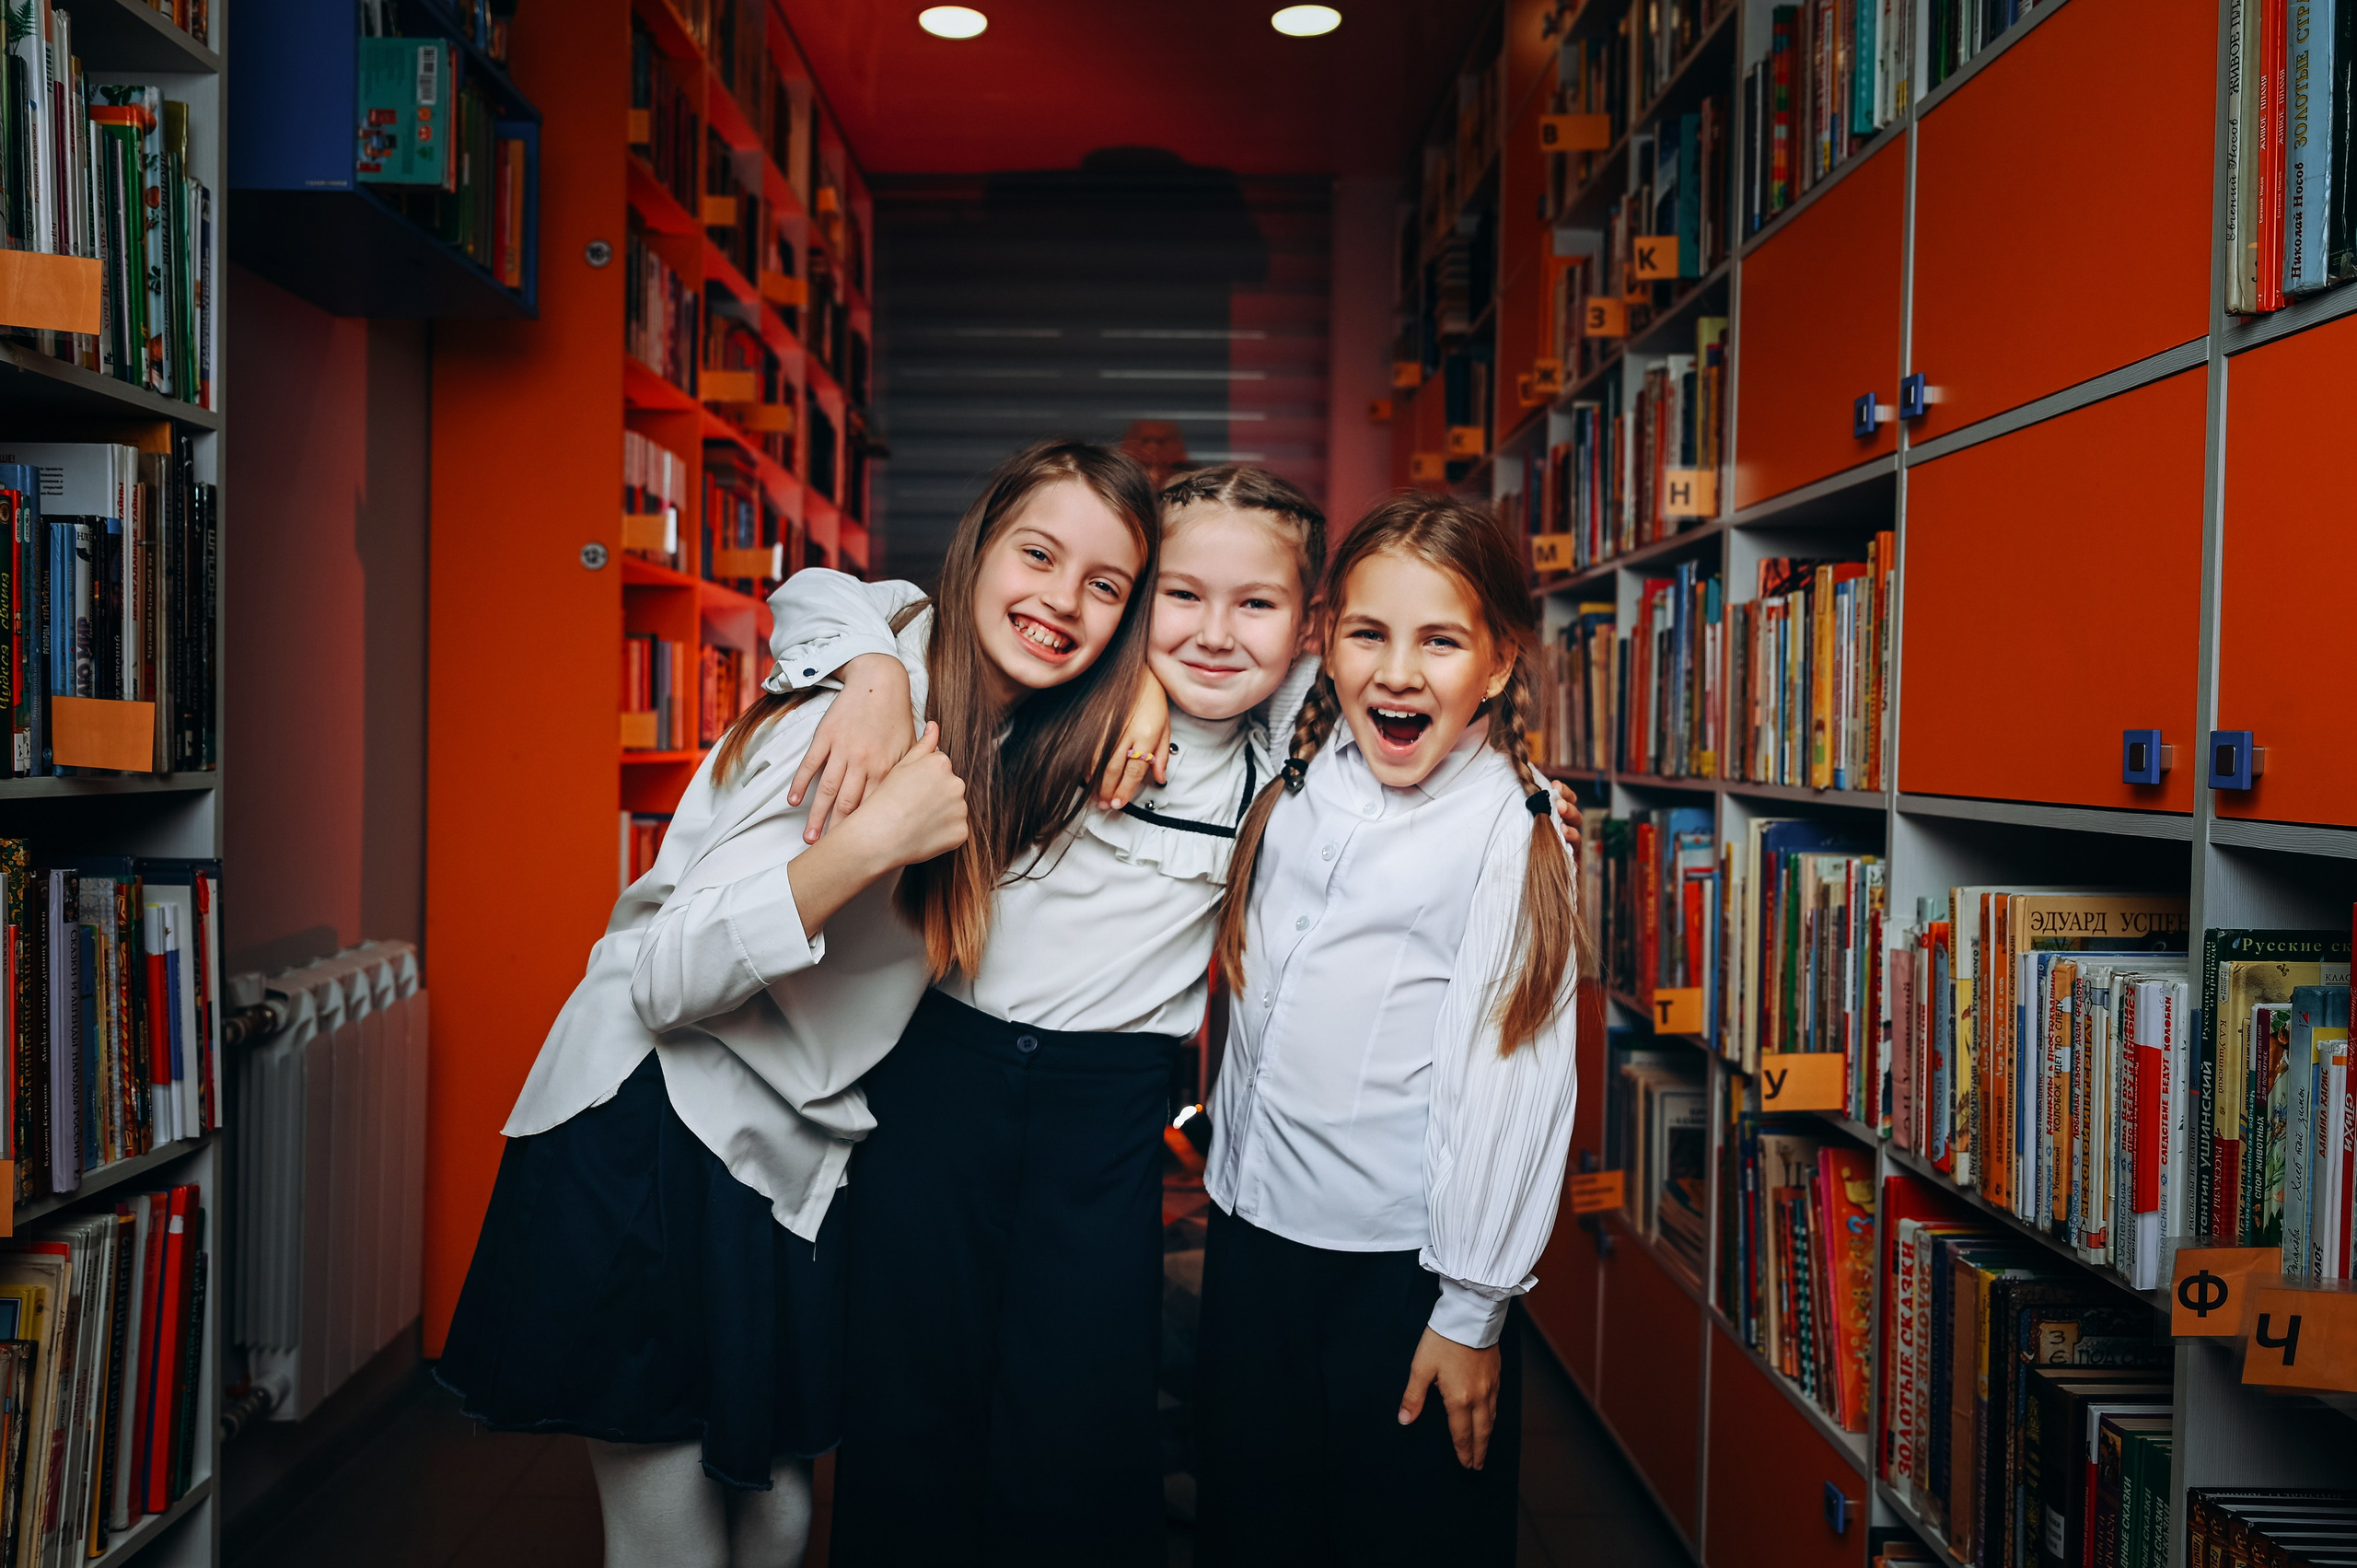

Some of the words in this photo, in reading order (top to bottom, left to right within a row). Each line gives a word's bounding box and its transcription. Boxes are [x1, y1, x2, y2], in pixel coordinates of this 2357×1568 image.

[2229, 31, 2241, 96] ЖИВОЕ
[2260, 74, 2269, 110] ПЛАМЯ
[2293, 50, 2309, 151] ЗОЛОТЫЕ
[2227, 119, 2239, 170] Носов
[2259, 114, 2268, 150] ЖИВОЕ
[32, 162, 41, 203] Растения
[2225, 174, 2238, 242] Евгений
[2293, 162, 2305, 208] Носов
[1638, 247, 1657, 272] К
[2291, 211, 2304, 279] Николай
[1669, 481, 1690, 506] Н
[0, 572, 10, 630] света
[41, 569, 51, 622] ПРИРОДЫ
[42, 624, 51, 655] РЕКОРДЫ
[75, 616, 91, 660] МИР
[0, 644, 10, 710] Чудеса
[2031, 912, 2107, 935] ЭДУАРД
[2243, 937, 2324, 957] Русские
[70, 929, 79, 977] СКАЗКИ
[2202, 941, 2212, 985] сказки
[2209, 941, 2217, 996] природе
[71, 981, 79, 991] И
[71, 993, 80, 1048] ЛЕГЕНДЫ
[1655, 998, 1676, 1027] Т
[2047, 969, 2057, 1063] ПРОСТОКВАШИНО
[2056, 999, 2065, 1031] СЛЕДУ
[2073, 1021, 2083, 1046] ДЯДИ
[2128, 985, 2136, 1064] АНФИСУ
[2164, 996, 2172, 1052] КОЛОБКИ
[2201, 988, 2211, 1041] Русские
[2219, 1019, 2227, 1040] К.Д.
[2055, 1055, 2064, 1079] ИДЕТ
[2056, 1035, 2063, 1051] ПО
[2217, 1042, 2227, 1094] Ушинский
[72, 1051, 80, 1107] НАРОДОВ
[1763, 1068, 1788, 1101] У
[2073, 1050, 2083, 1089] ДЕВОЧКА
[2083, 1015, 2093, 1123] ИНТЕРНАТ
[2319, 1067, 2329, 1108] ХАРМС
[2045, 1075, 2055, 1137] КАНИКУЛЫ
[2054, 1084, 2062, 1133] КОЛОБОК
[2073, 1093, 2082, 1141] ЛЮБИМАЯ
[2200, 1061, 2212, 1167] УШИНСКИЙ
[2298, 1086, 2309, 1131] зимы
[73, 1109, 81, 1160] РОССИИ
[2161, 1099, 2169, 1167] СЛЕДСТВИЕ
[2256, 1115, 2265, 1173] ЖИВОТНЫХ
[2295, 1132, 2305, 1156] той
[2317, 1109, 2328, 1159] ДАНИИЛ
[2054, 1193, 2061, 1202] Э.
[2080, 1125, 2090, 1219] МЕХОВОЙ
[2189, 1168, 2196, 1178] И
[2214, 1144, 2223, 1208] РАССКАЗЫ
[2240, 1150, 2248, 1202] ЧЕТЫРЕ
[2255, 1173, 2263, 1200] СПОР
[2290, 1156, 2304, 1202] Хлеб
[2189, 1181, 2197, 1232] РАССКАЗЫ
[2213, 1212, 2222, 1223] И
[2245, 1184, 2253, 1232] Рассказы
[118, 1235, 133, 1291] ДЕЛЕ?
[1898, 1241, 1914, 1348] СКАЗКИ
[2177, 1269, 2229, 1318] Ф
[112, 1295, 129, 1358] САМОМ
[1915, 1262, 1931, 1383] ЗОЛОТЫЕ
[2255, 1313, 2303, 1367] Ч
[1897, 1352, 1914, 1479] ЗОЛОТЫЕ
[1913, 1388, 1928, 1492] СКАЗКИ
[2120, 1475, 2132, 1529] СКАЗКИ
[2142, 1487, 2153, 1536] СКАЗКИ
[2154, 1496, 2165, 1548] СКАЗКИ
[2161, 1504, 2171, 1558] СКАЗКИ
